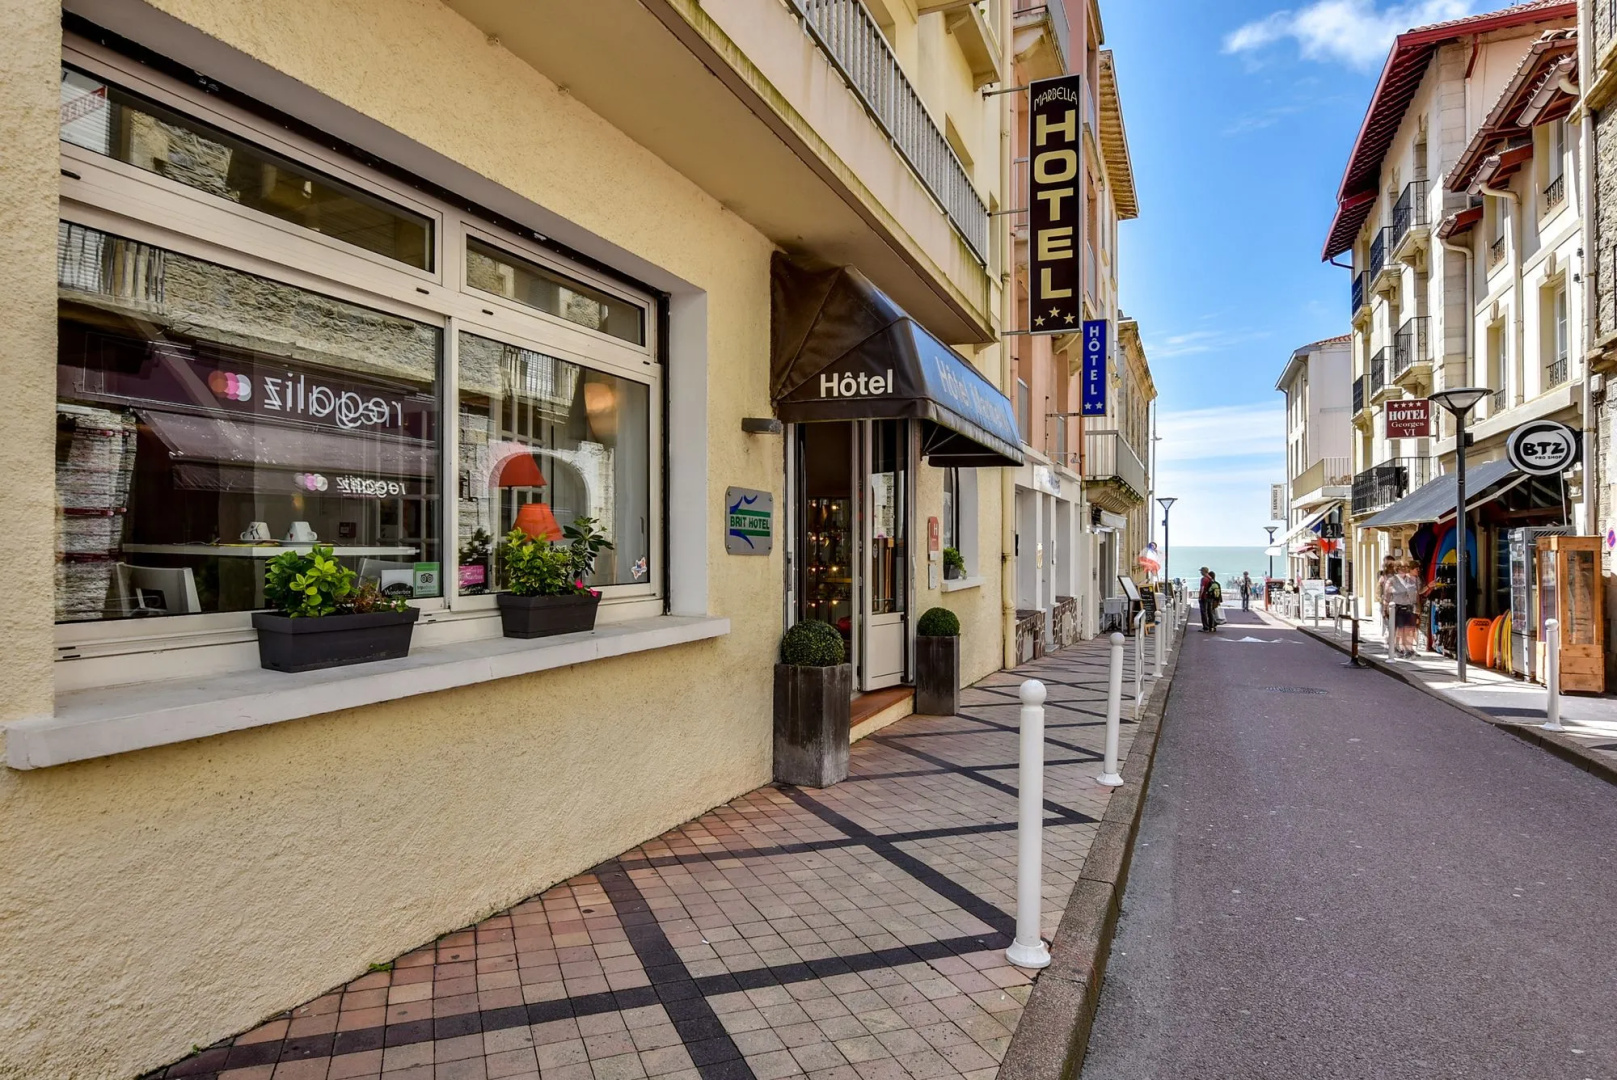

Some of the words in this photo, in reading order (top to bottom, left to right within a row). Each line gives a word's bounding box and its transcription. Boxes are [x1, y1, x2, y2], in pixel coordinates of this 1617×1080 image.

[1033, 86, 1078, 112] MARBELLA
[1034, 109, 1077, 299] HOTEL
[1088, 325, 1101, 395] HÔTEL
[820, 368, 894, 398] Hôtel
[1388, 409, 1428, 421] HOTEL
[1403, 428, 1416, 436] VI
[1522, 441, 1566, 456] BTZ
[730, 516, 747, 527] BRIT
[748, 517, 770, 530] HOTEL
